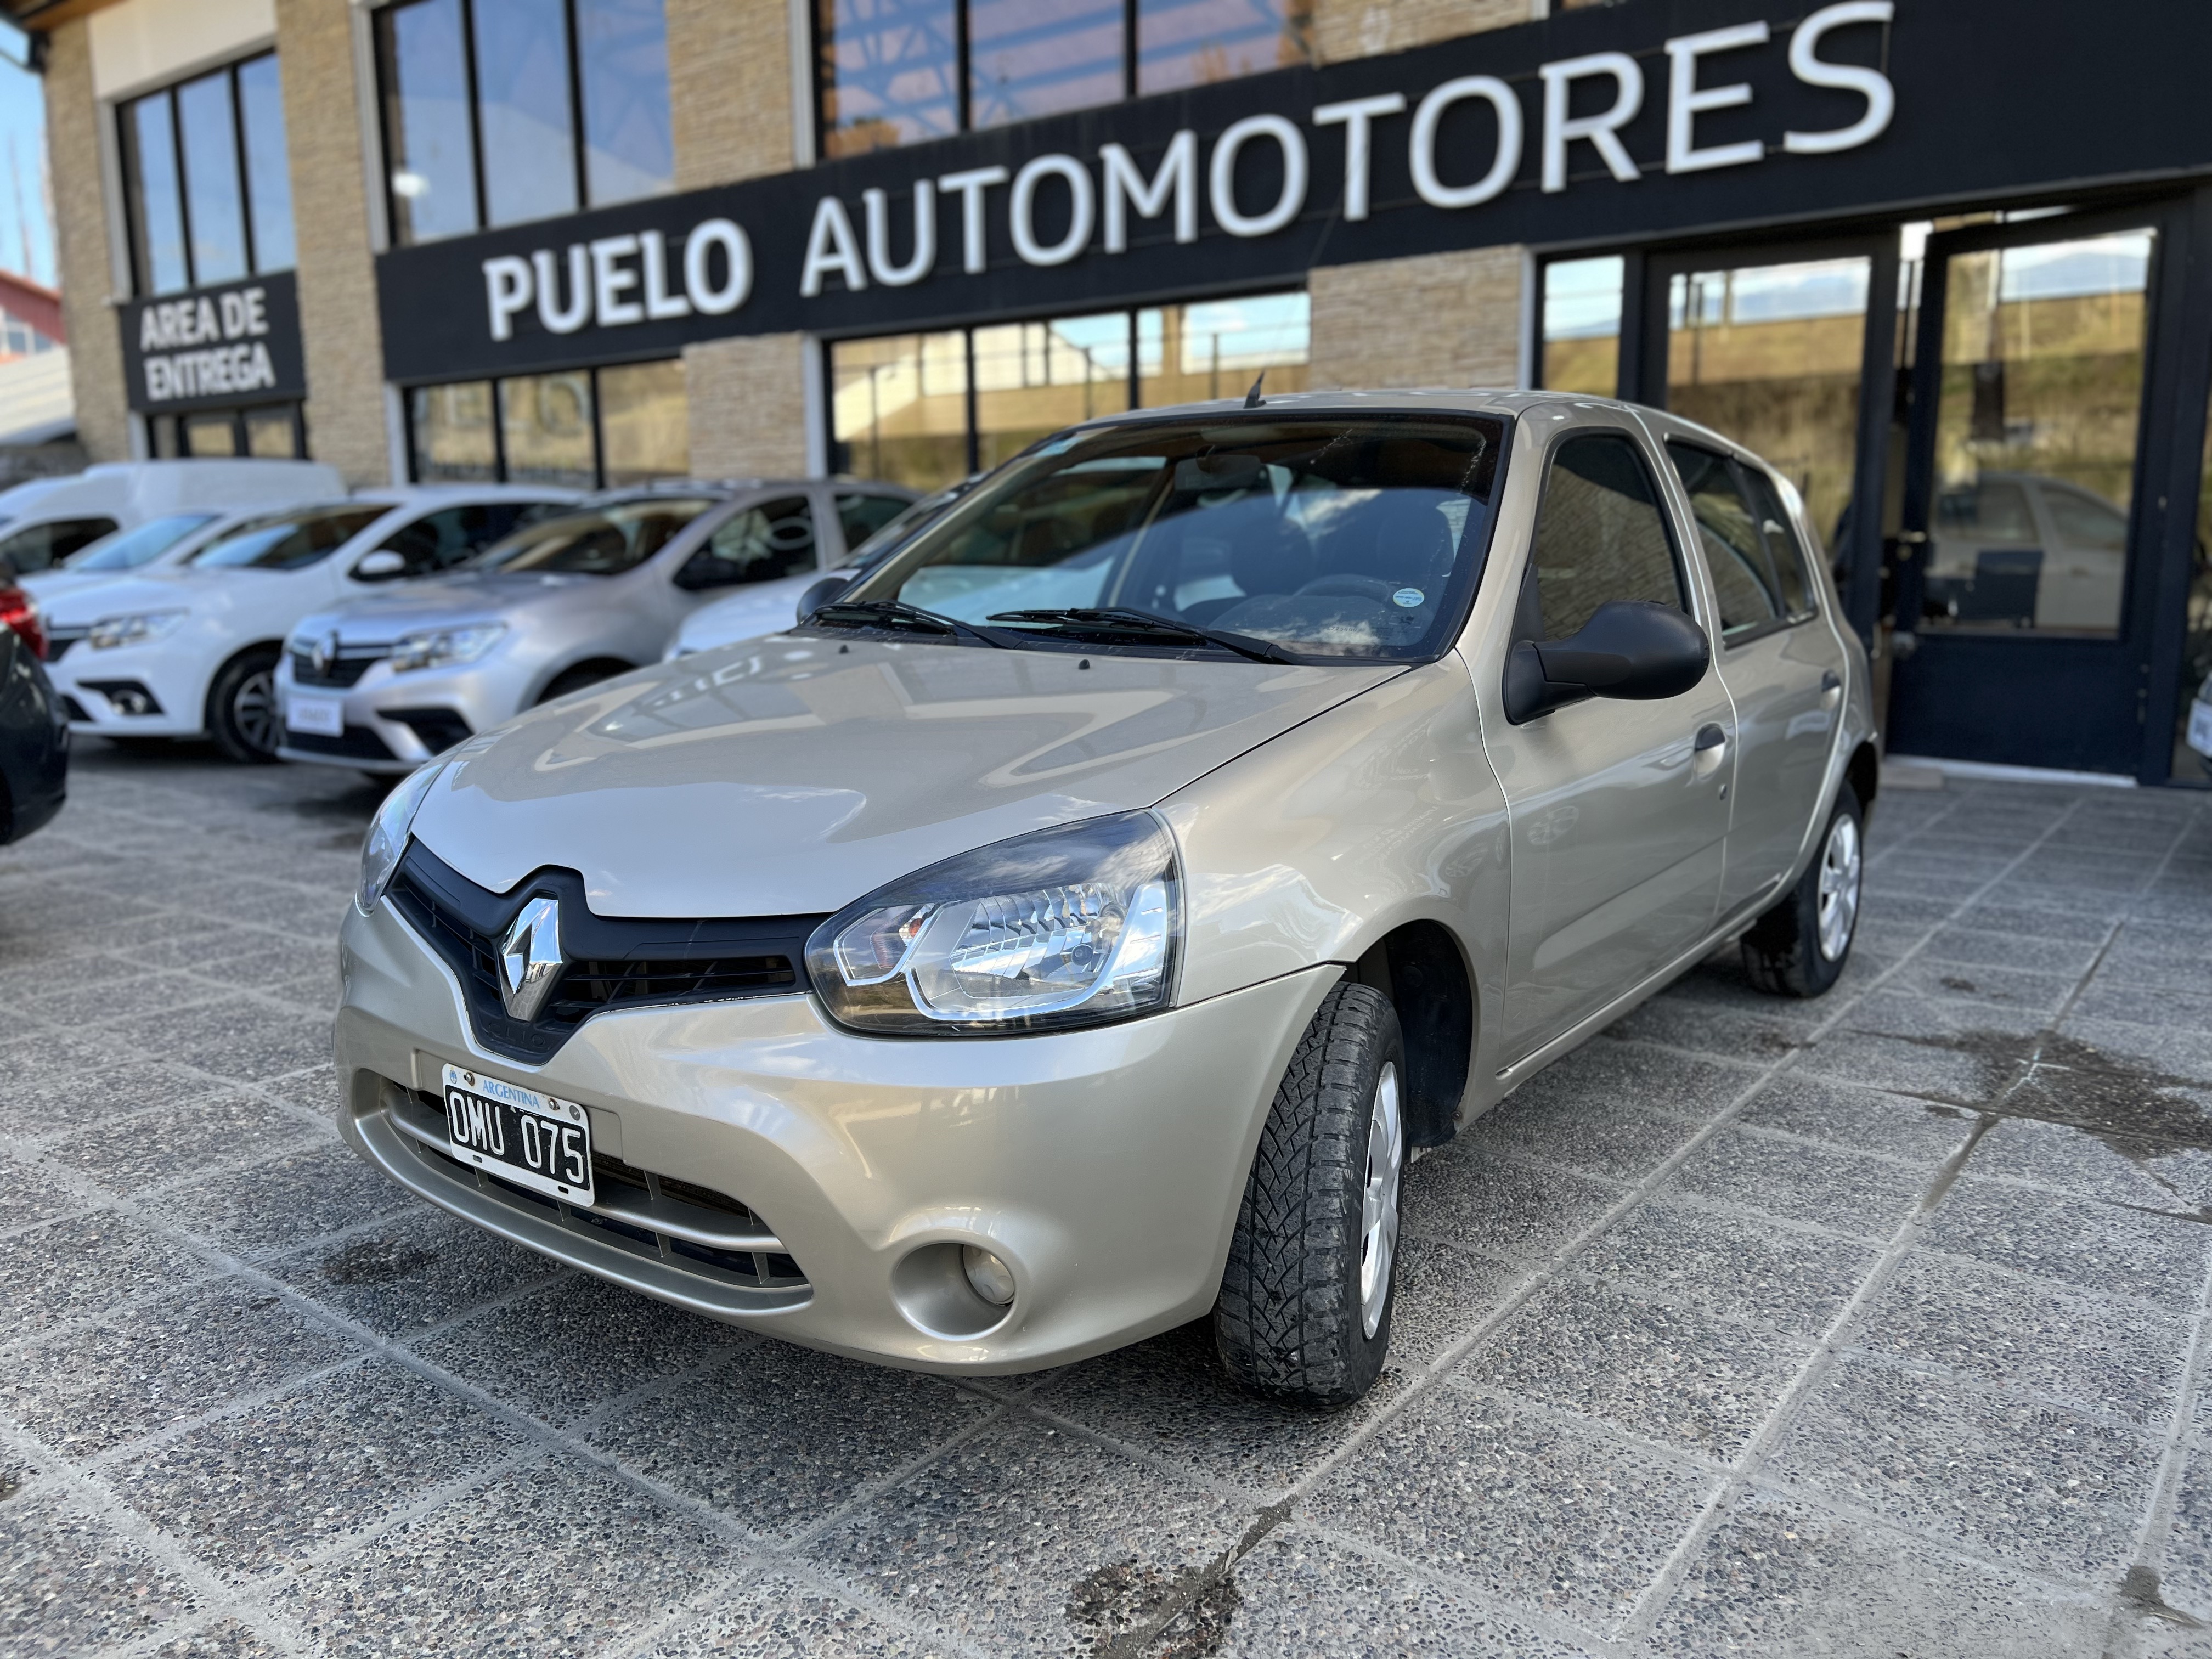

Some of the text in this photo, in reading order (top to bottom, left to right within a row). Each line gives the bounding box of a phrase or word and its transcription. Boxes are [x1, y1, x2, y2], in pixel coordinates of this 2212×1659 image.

[483, 1, 1894, 341] PUELO AUTOMOTORES
[140, 286, 269, 351] AREA DE
[143, 342, 275, 401] ENTREGA
[488, 1023, 545, 1046] CLIO
[483, 1080, 540, 1109] ARGENTINA
[449, 1091, 584, 1184] OMU 075
